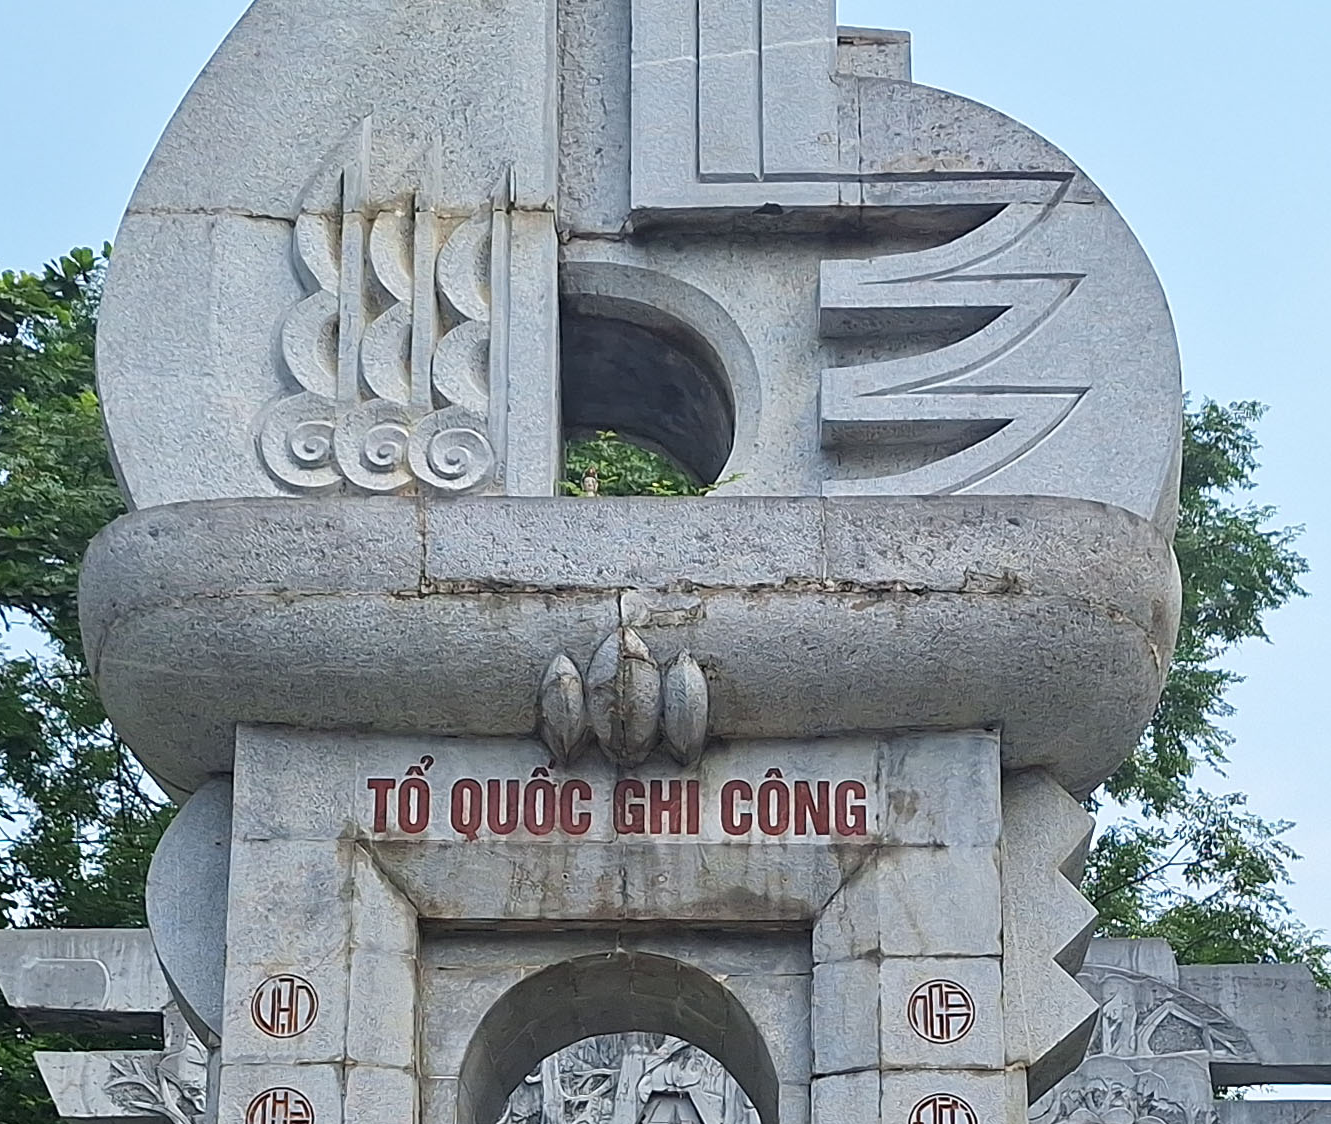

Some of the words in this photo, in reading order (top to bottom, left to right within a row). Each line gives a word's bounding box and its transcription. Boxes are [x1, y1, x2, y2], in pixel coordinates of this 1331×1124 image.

[367, 755, 434, 834] TỔ
[450, 759, 592, 842] QUỐC
[614, 778, 700, 836] GHI
[720, 767, 867, 836] CÔNG
